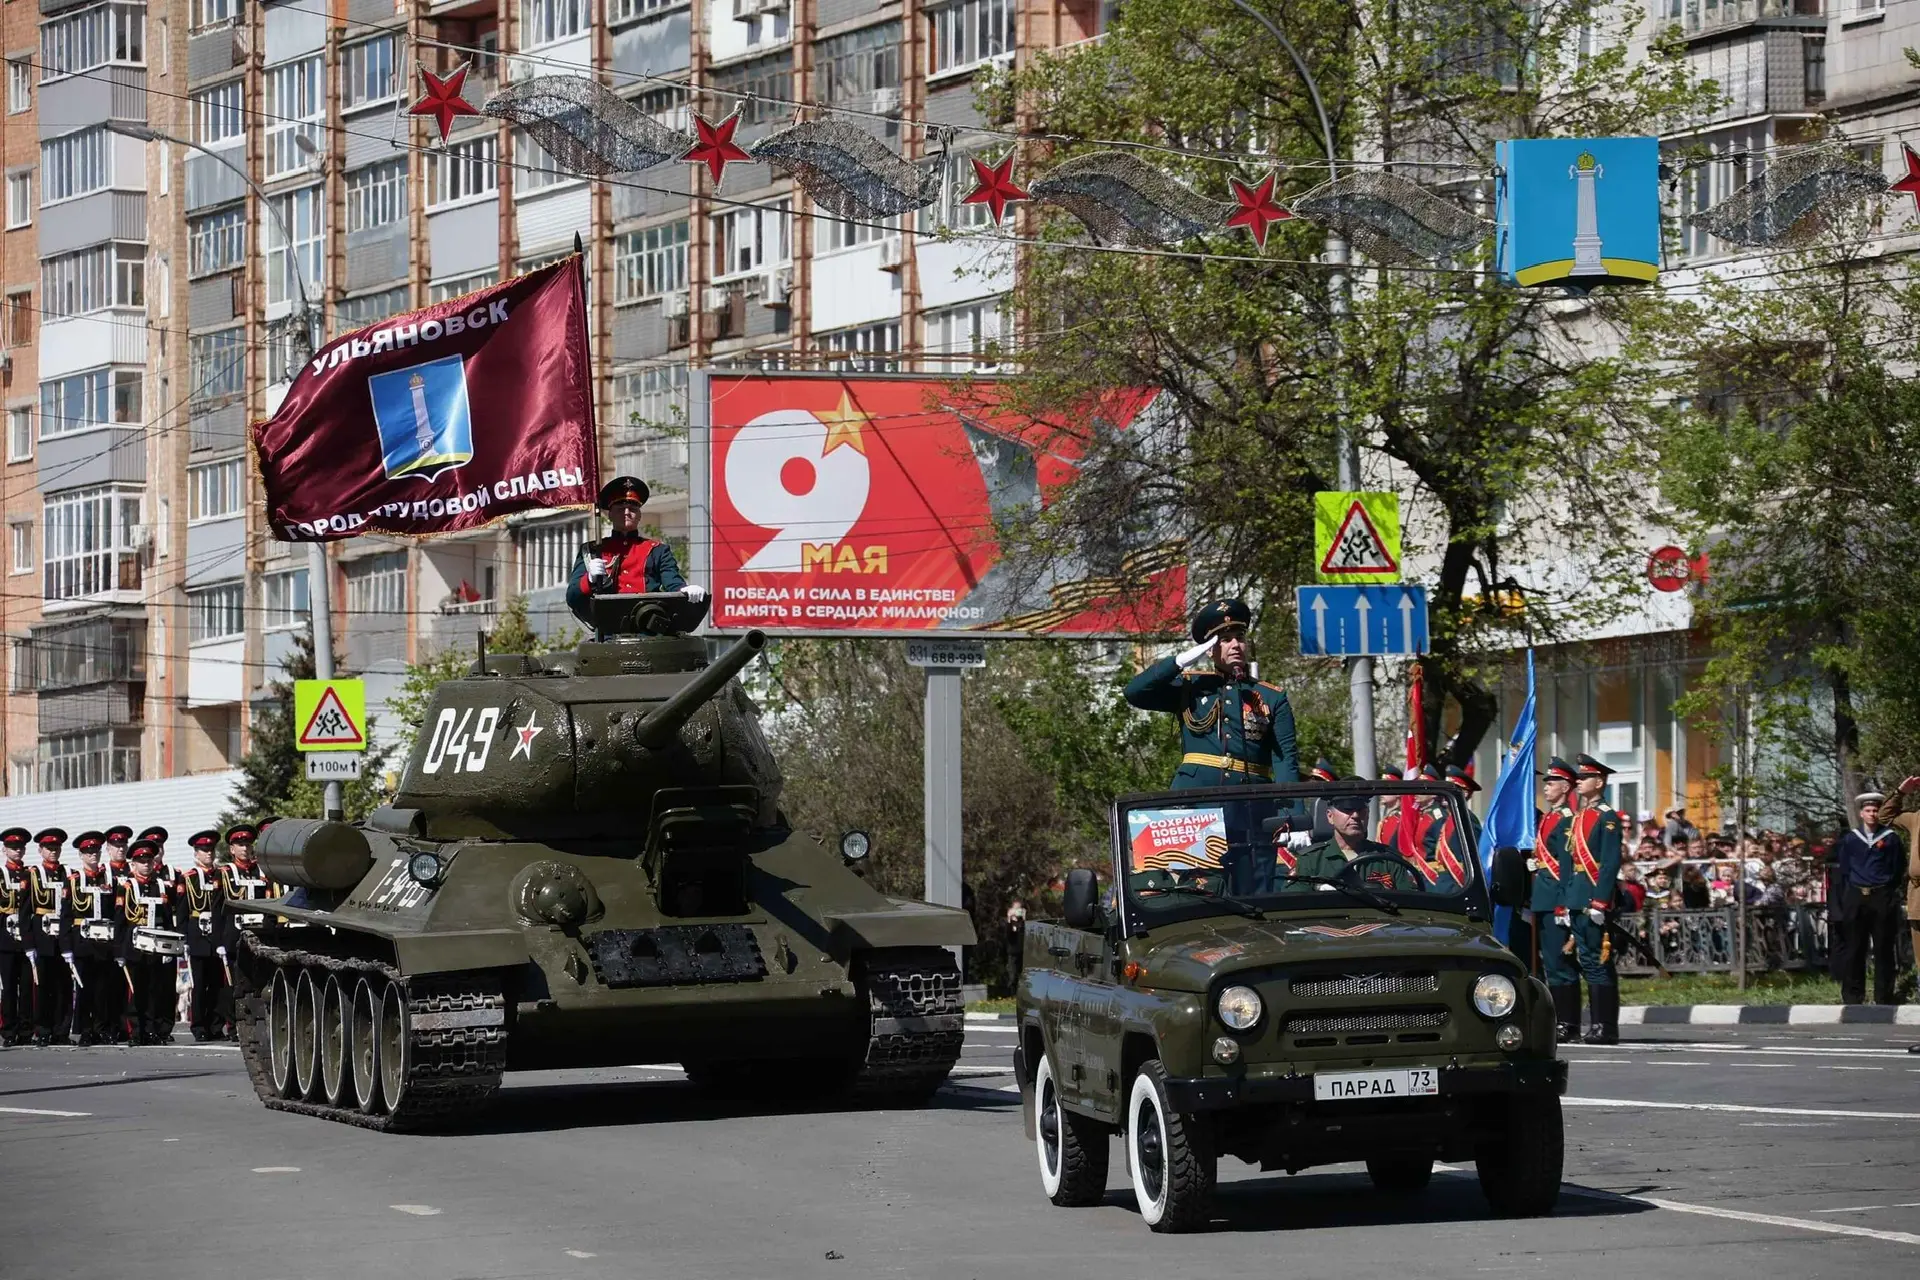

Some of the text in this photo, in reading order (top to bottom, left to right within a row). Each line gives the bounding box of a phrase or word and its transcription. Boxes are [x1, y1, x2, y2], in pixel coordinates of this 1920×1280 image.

[312, 298, 509, 376] УЛЬЯНОВСК
[725, 409, 870, 572] 9
[284, 512, 364, 540] ГОРОД
[494, 466, 584, 500] СЛАВЫ
[802, 543, 887, 573] МАЯ
[724, 588, 956, 603] ПОБЕДА И СИЛА В ЕДИНСТВЕ!
[724, 605, 985, 620] ПАМЯТЬ В СЕРДЦАХ МИЛЛИОНОВ!
[931, 652, 983, 664] 688-993
[422, 707, 500, 774] 049
[319, 761, 348, 772] 100м
[1149, 813, 1219, 829] СОХРАНИМ
[1151, 824, 1202, 838] ПОБЕДУ
[1153, 831, 1206, 847] ВМЕСТЕ!
[1331, 1071, 1430, 1096] ПАРАД 73
